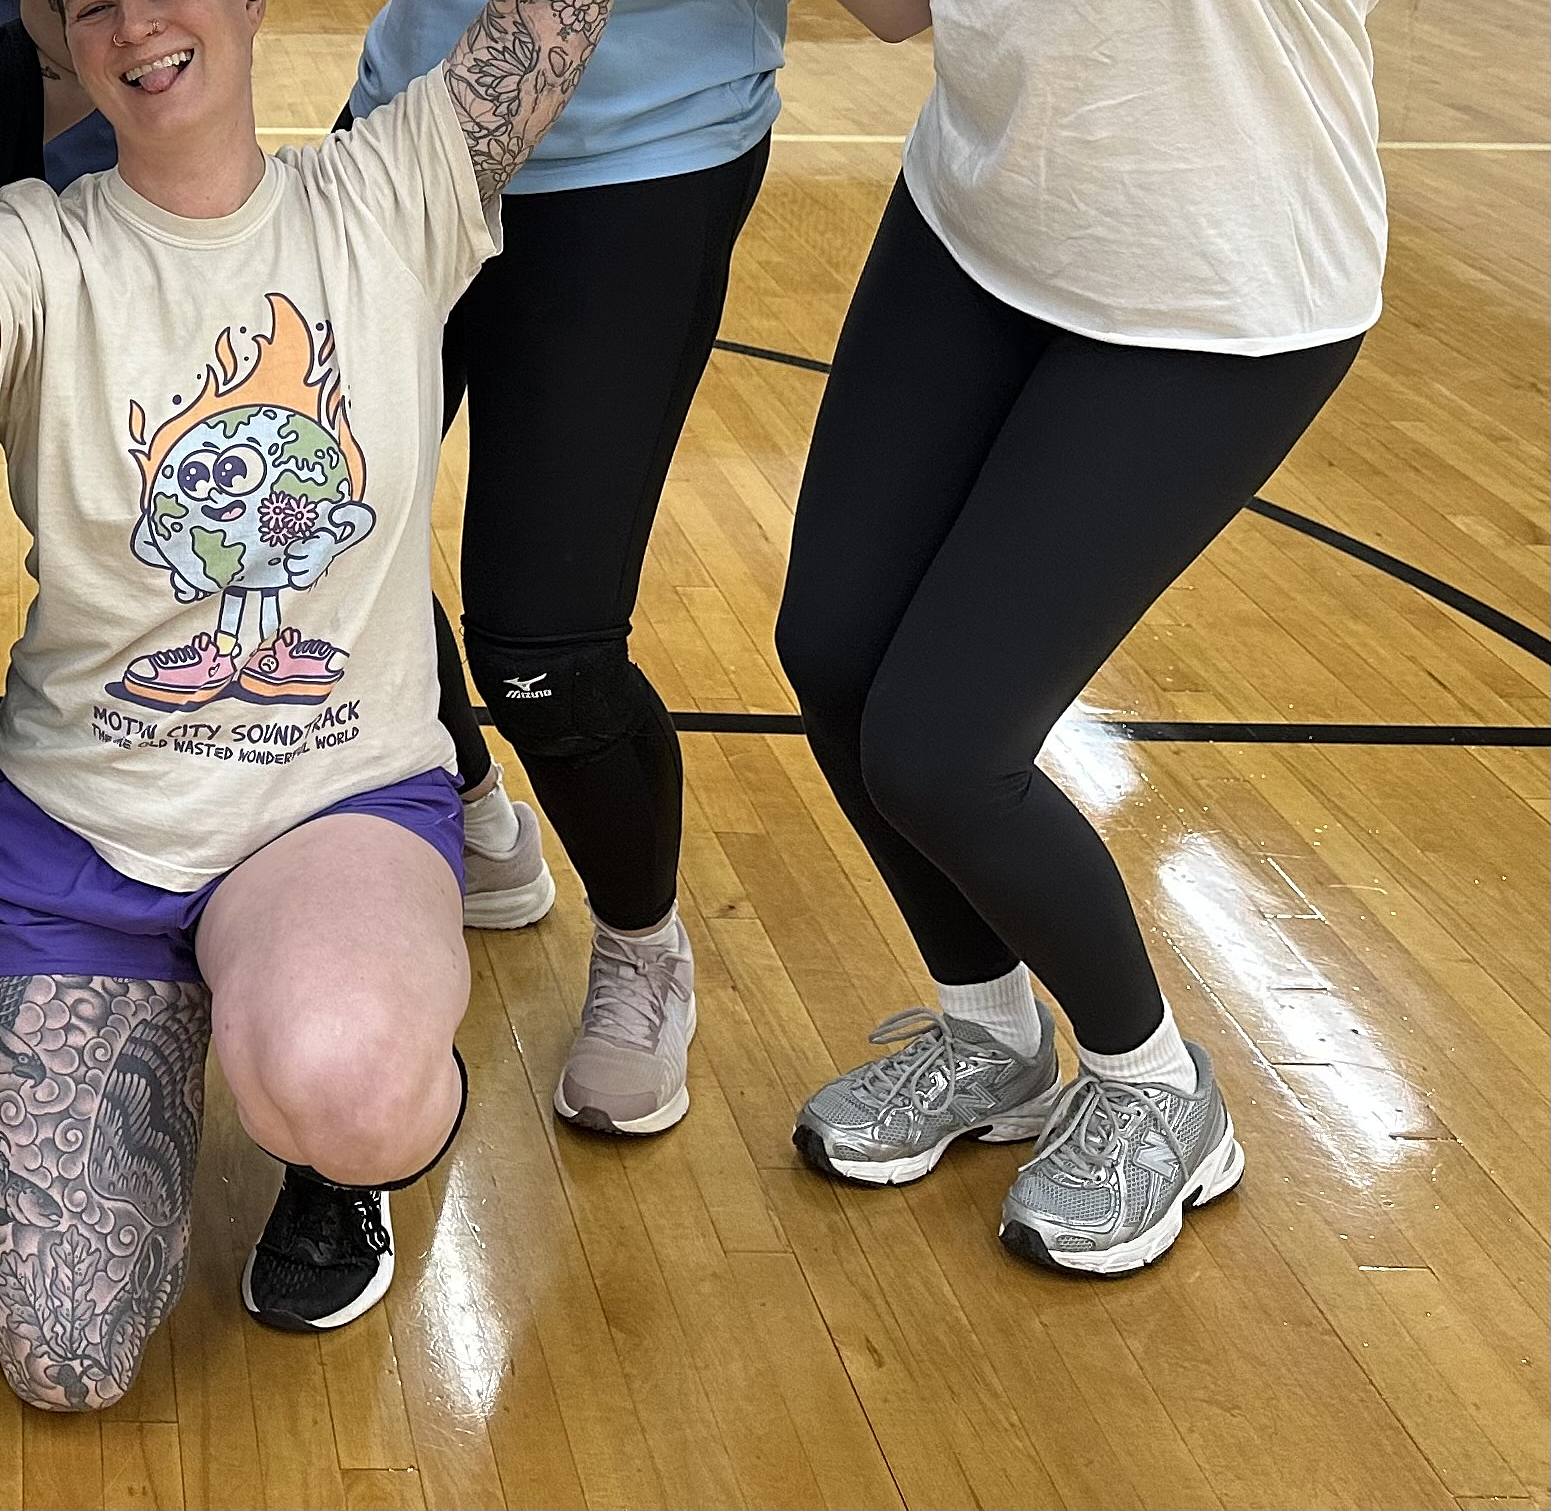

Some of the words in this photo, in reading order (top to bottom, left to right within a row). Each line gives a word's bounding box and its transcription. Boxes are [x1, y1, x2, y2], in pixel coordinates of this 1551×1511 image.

[167, 724, 222, 740] CITY
[231, 699, 360, 746] SOUNDTRACK
[174, 739, 233, 761] WASTED
[315, 726, 359, 750] WORLD
